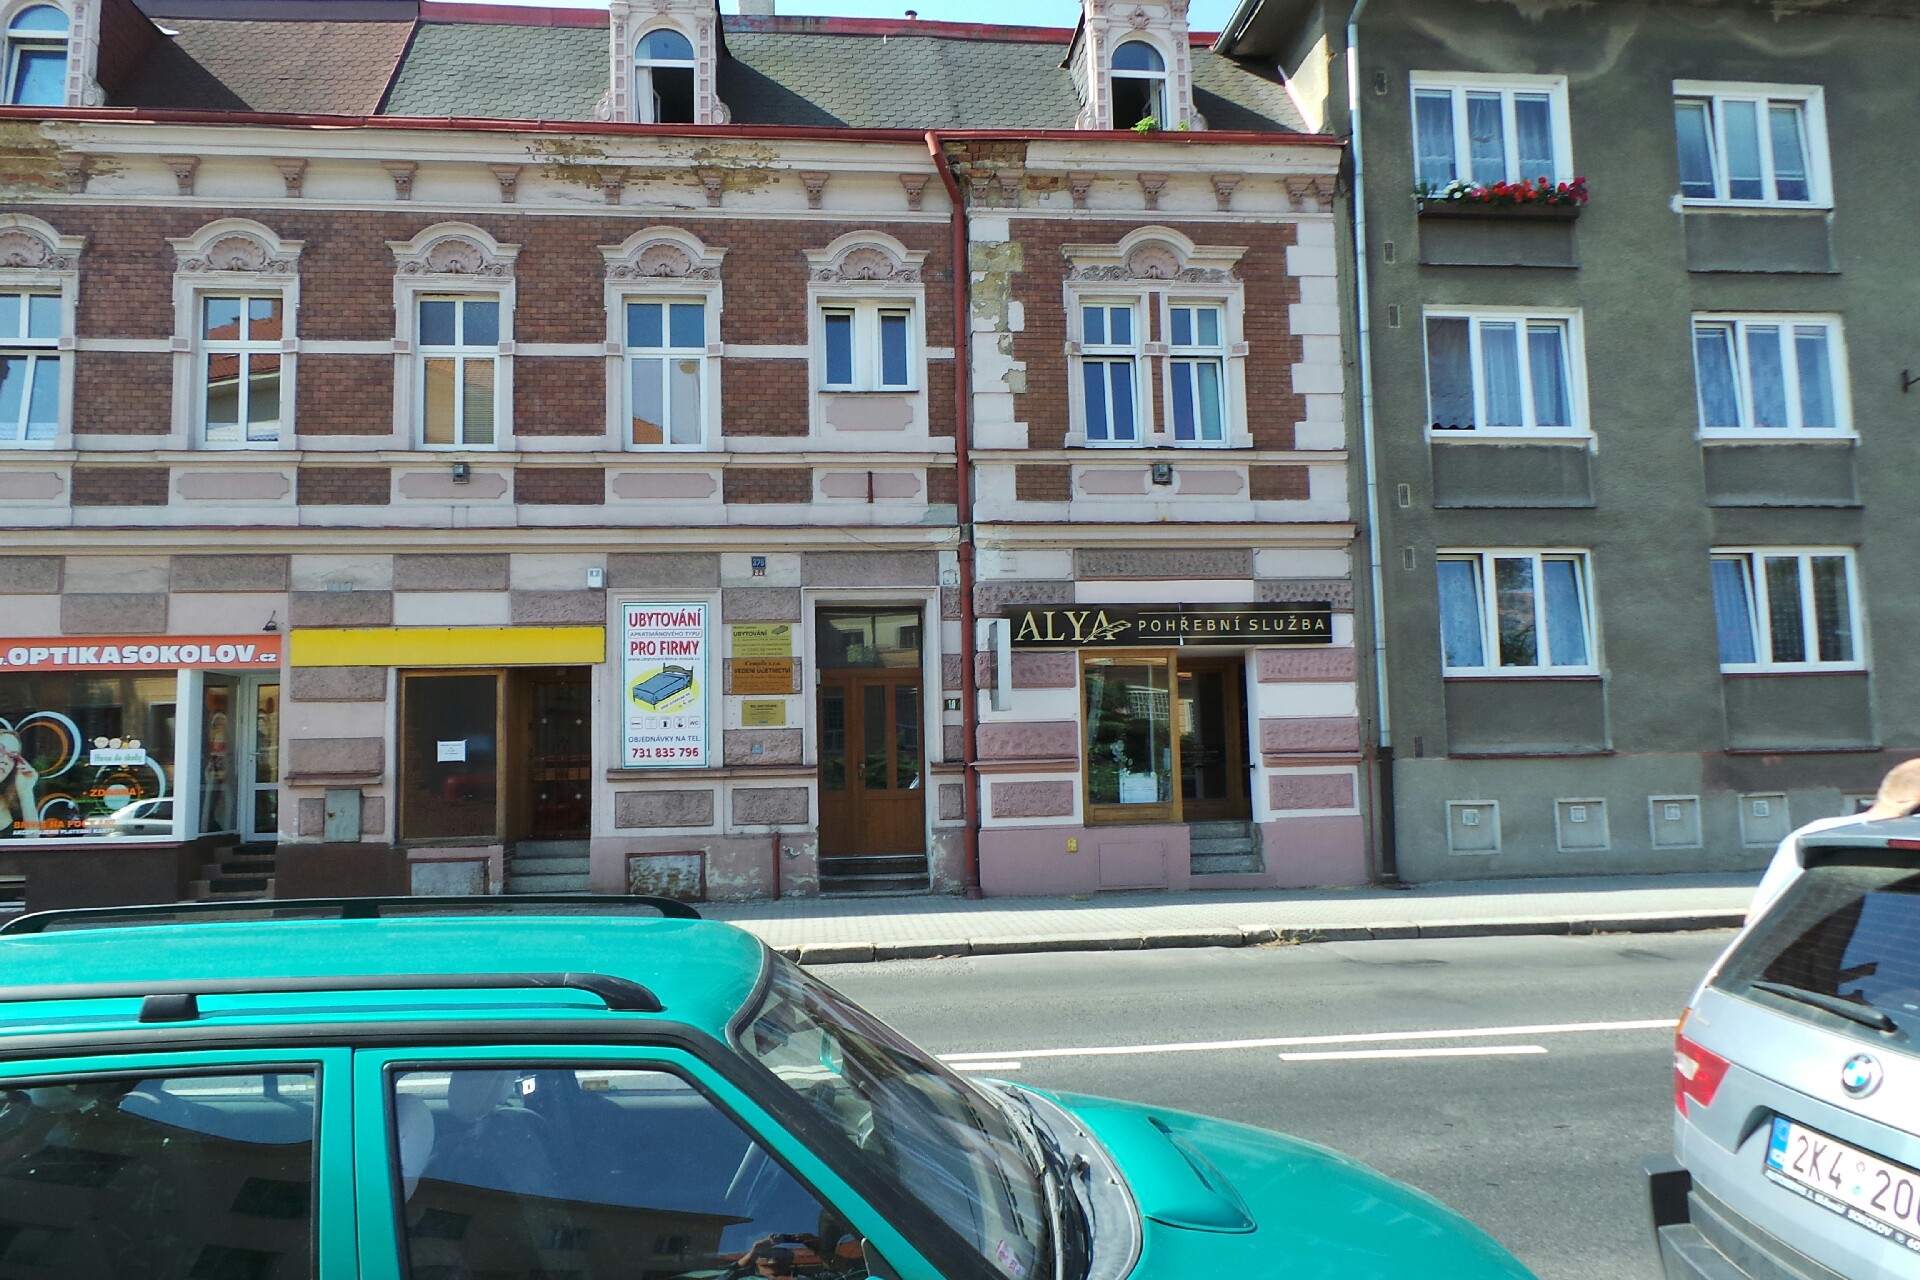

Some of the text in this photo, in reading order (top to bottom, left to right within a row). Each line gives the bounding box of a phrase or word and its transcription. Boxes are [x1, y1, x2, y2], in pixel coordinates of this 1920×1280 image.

[629, 608, 701, 628] UBYTOVÁNÍ
[1014, 610, 1326, 643] ALYA POHŘEBNÍ SLUŽBA
[630, 640, 700, 656] PRO FIRMY
[628, 735, 674, 743] OBJEDNÁVKY
[632, 747, 699, 758] 731 835 796
[1792, 1134, 1842, 1190] 2K4
